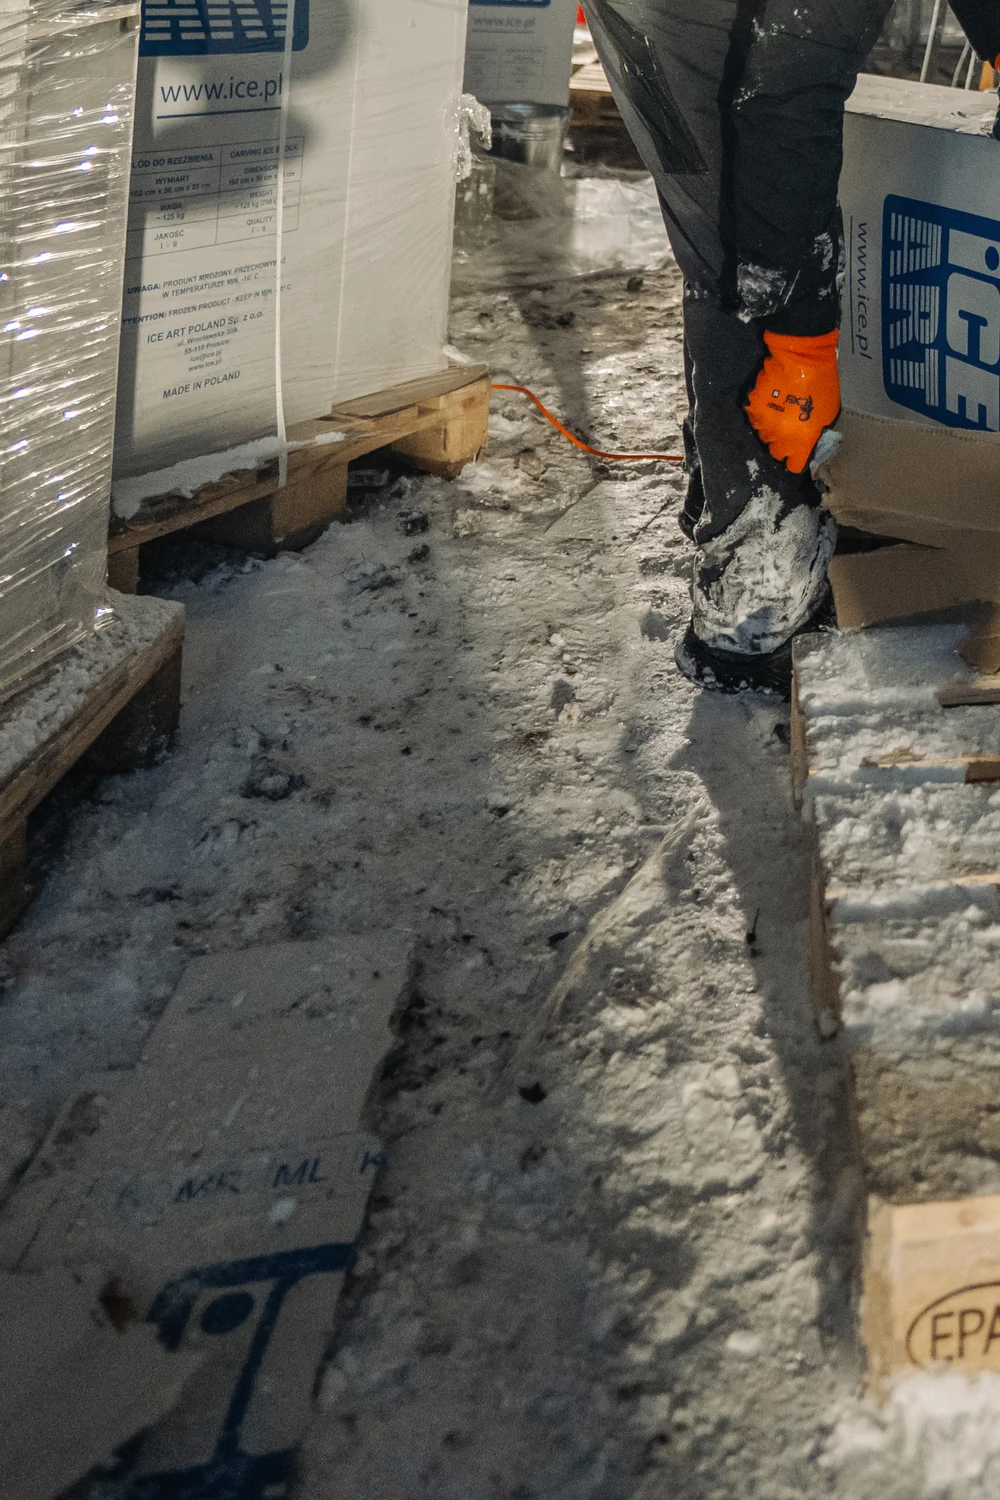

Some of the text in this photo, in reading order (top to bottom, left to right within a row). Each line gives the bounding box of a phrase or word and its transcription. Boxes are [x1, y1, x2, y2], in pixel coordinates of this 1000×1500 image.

[161, 73, 283, 103] www.ice.pl
[152, 158, 166, 167] DO
[246, 216, 273, 226] QUALITY
[154, 229, 185, 241] JAKOŚĆ
[127, 283, 161, 294] UWAGA:
[162, 276, 197, 288] PRODUKT
[171, 280, 226, 297] TEMPERATURZE
[855, 221, 873, 361] www.ice.pl
[122, 312, 167, 326] TTENTION:
[168, 305, 197, 317] FROZEN
[198, 298, 231, 310] PRODUCT
[889, 212, 942, 407] ART
[147, 332, 164, 344] ICE
[165, 327, 186, 340] ART
[187, 318, 226, 334] POLAND
[162, 370, 241, 399] MADE IN POLAND
